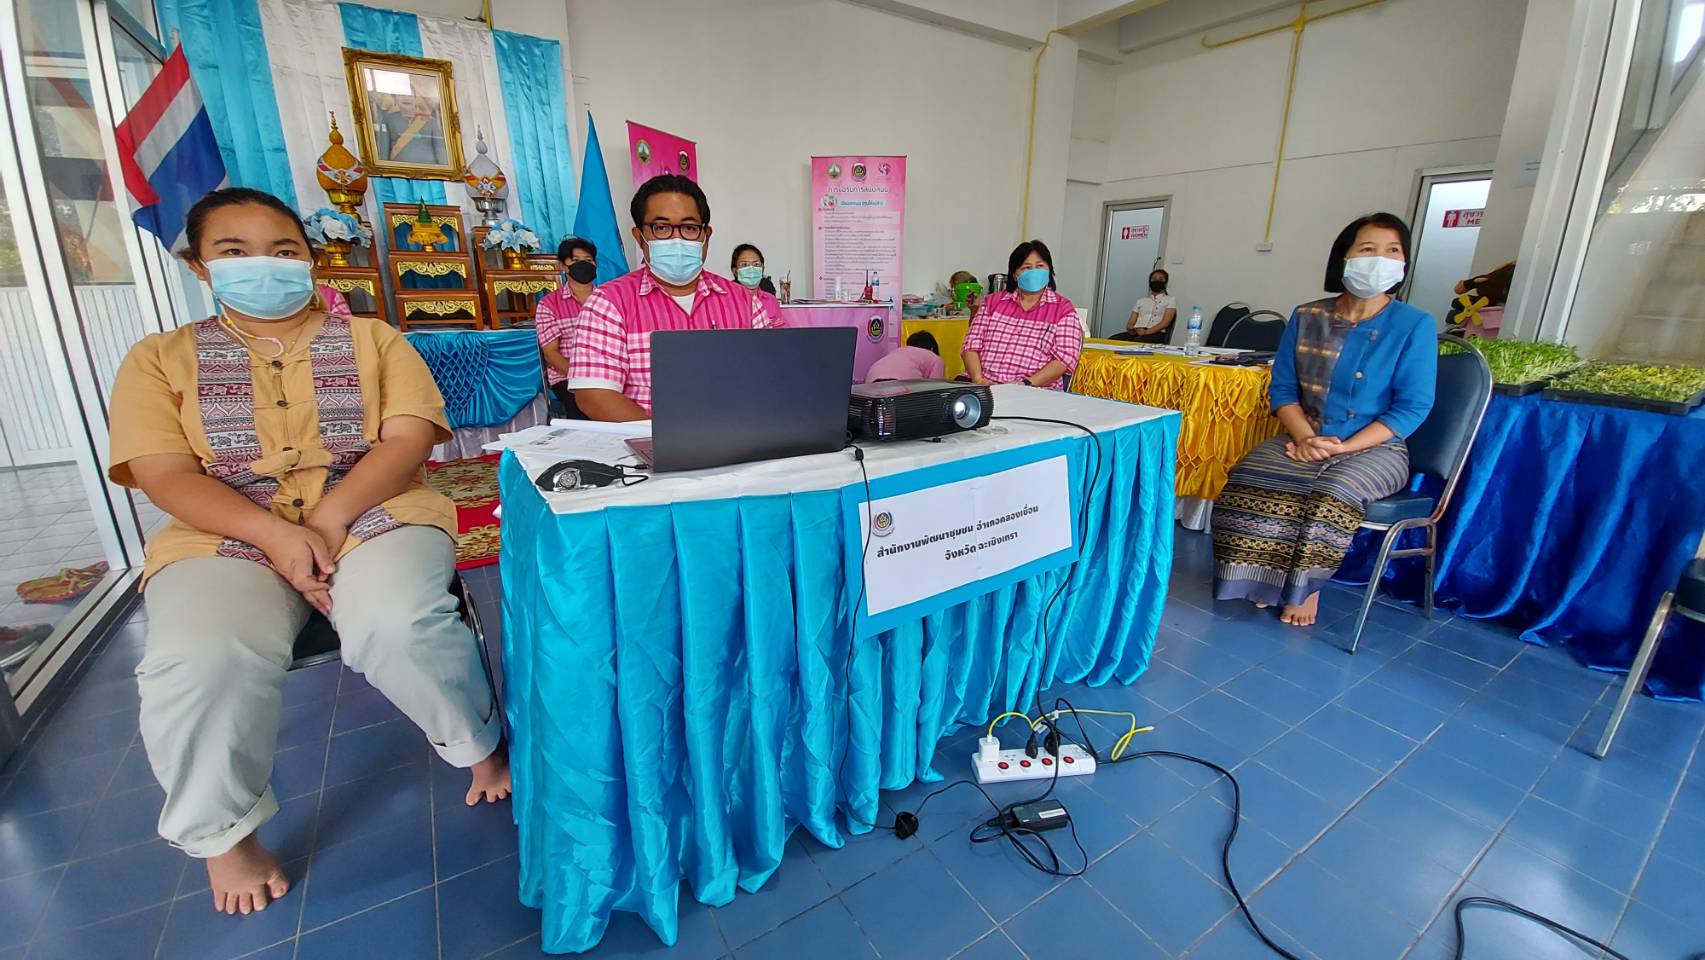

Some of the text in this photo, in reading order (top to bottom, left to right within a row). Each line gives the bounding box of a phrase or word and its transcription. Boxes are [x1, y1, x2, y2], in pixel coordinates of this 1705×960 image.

[877, 525, 974, 558] สำนักงานพัฒนาชุมชน
[976, 504, 1039, 531] อำเภอคลองเขื่อน
[945, 531, 1018, 560] จังหวัด ฉะเชิงเทรา
